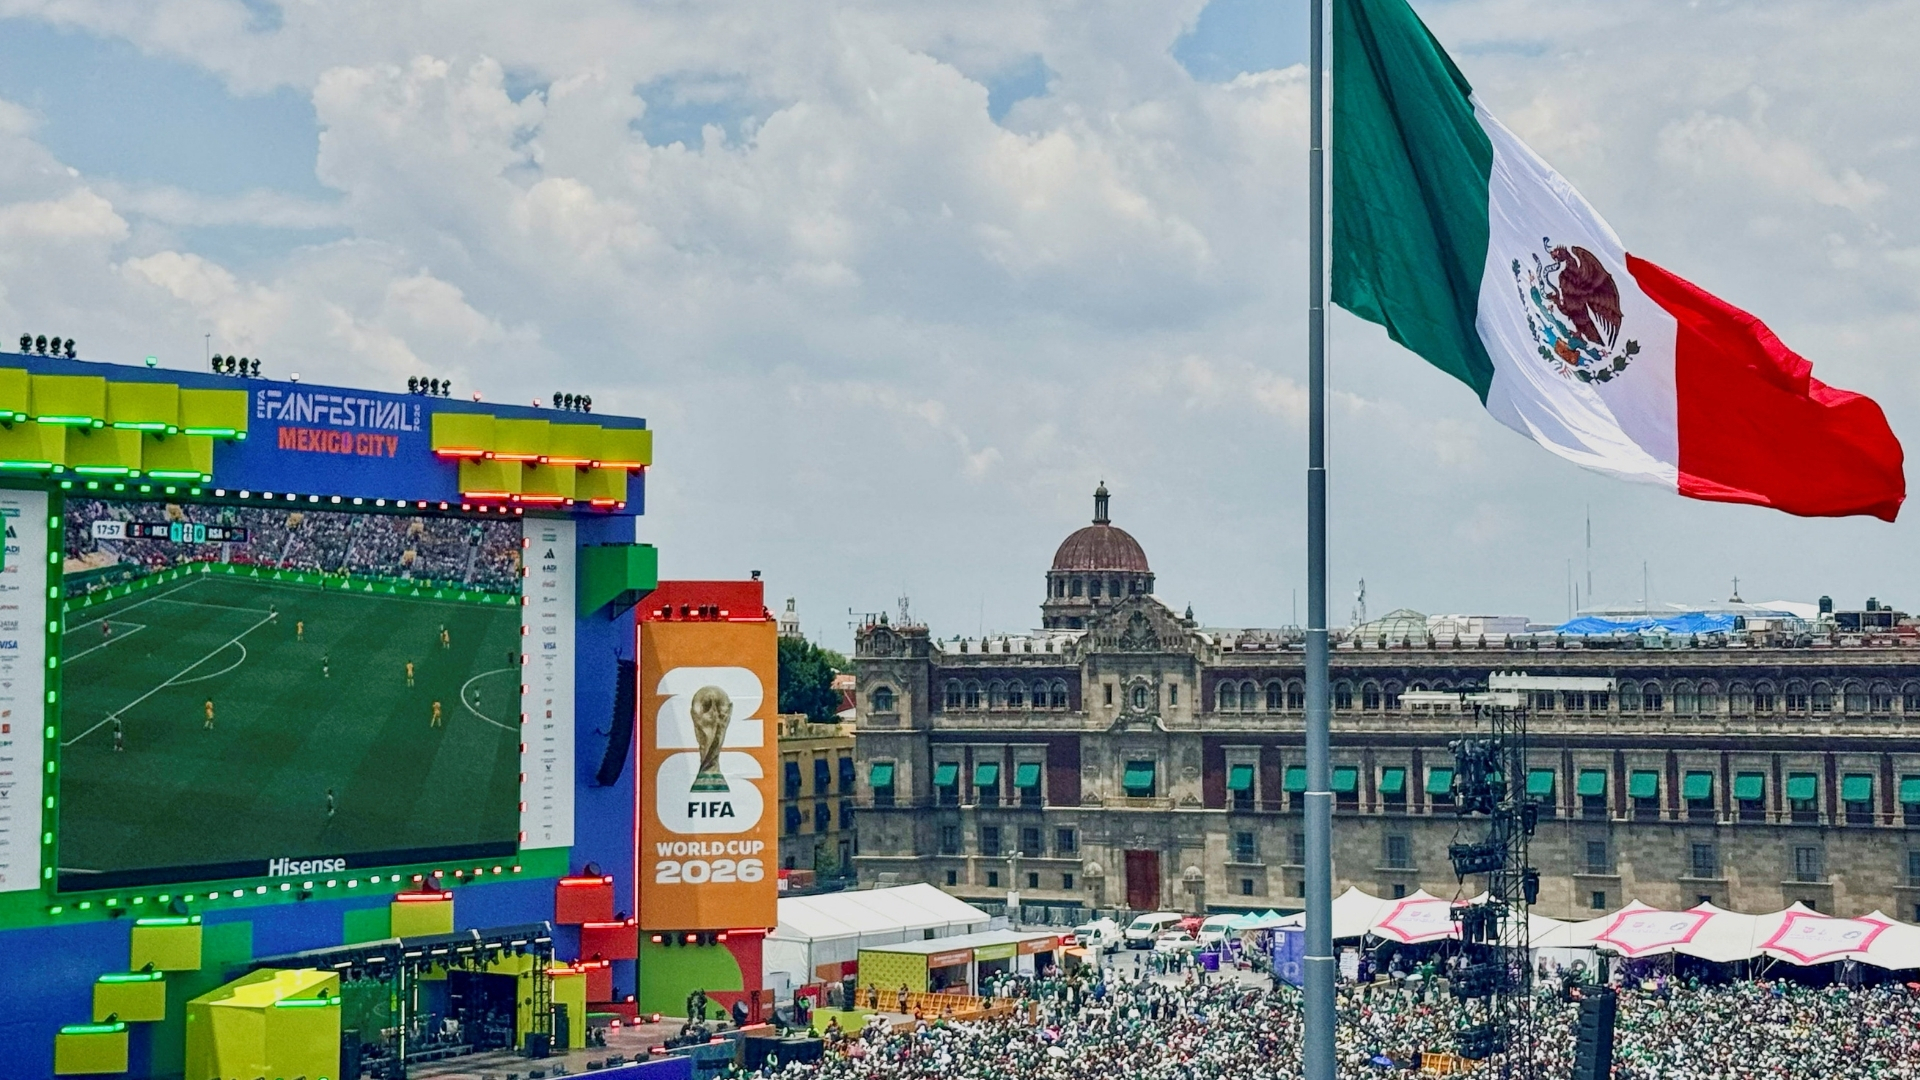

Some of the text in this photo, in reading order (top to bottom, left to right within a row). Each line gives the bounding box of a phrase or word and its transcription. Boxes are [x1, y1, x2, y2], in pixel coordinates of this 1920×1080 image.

[257, 389, 266, 419] FIFA
[278, 427, 399, 458] MEXICO CITY
[96, 524, 121, 535] 17:57
[152, 525, 168, 537] MEX
[208, 528, 223, 539] RSA
[688, 801, 735, 818] FIFA
[656, 840, 765, 857] WORLD CUP
[268, 857, 346, 877] Hisense
[655, 858, 765, 884] 2026
